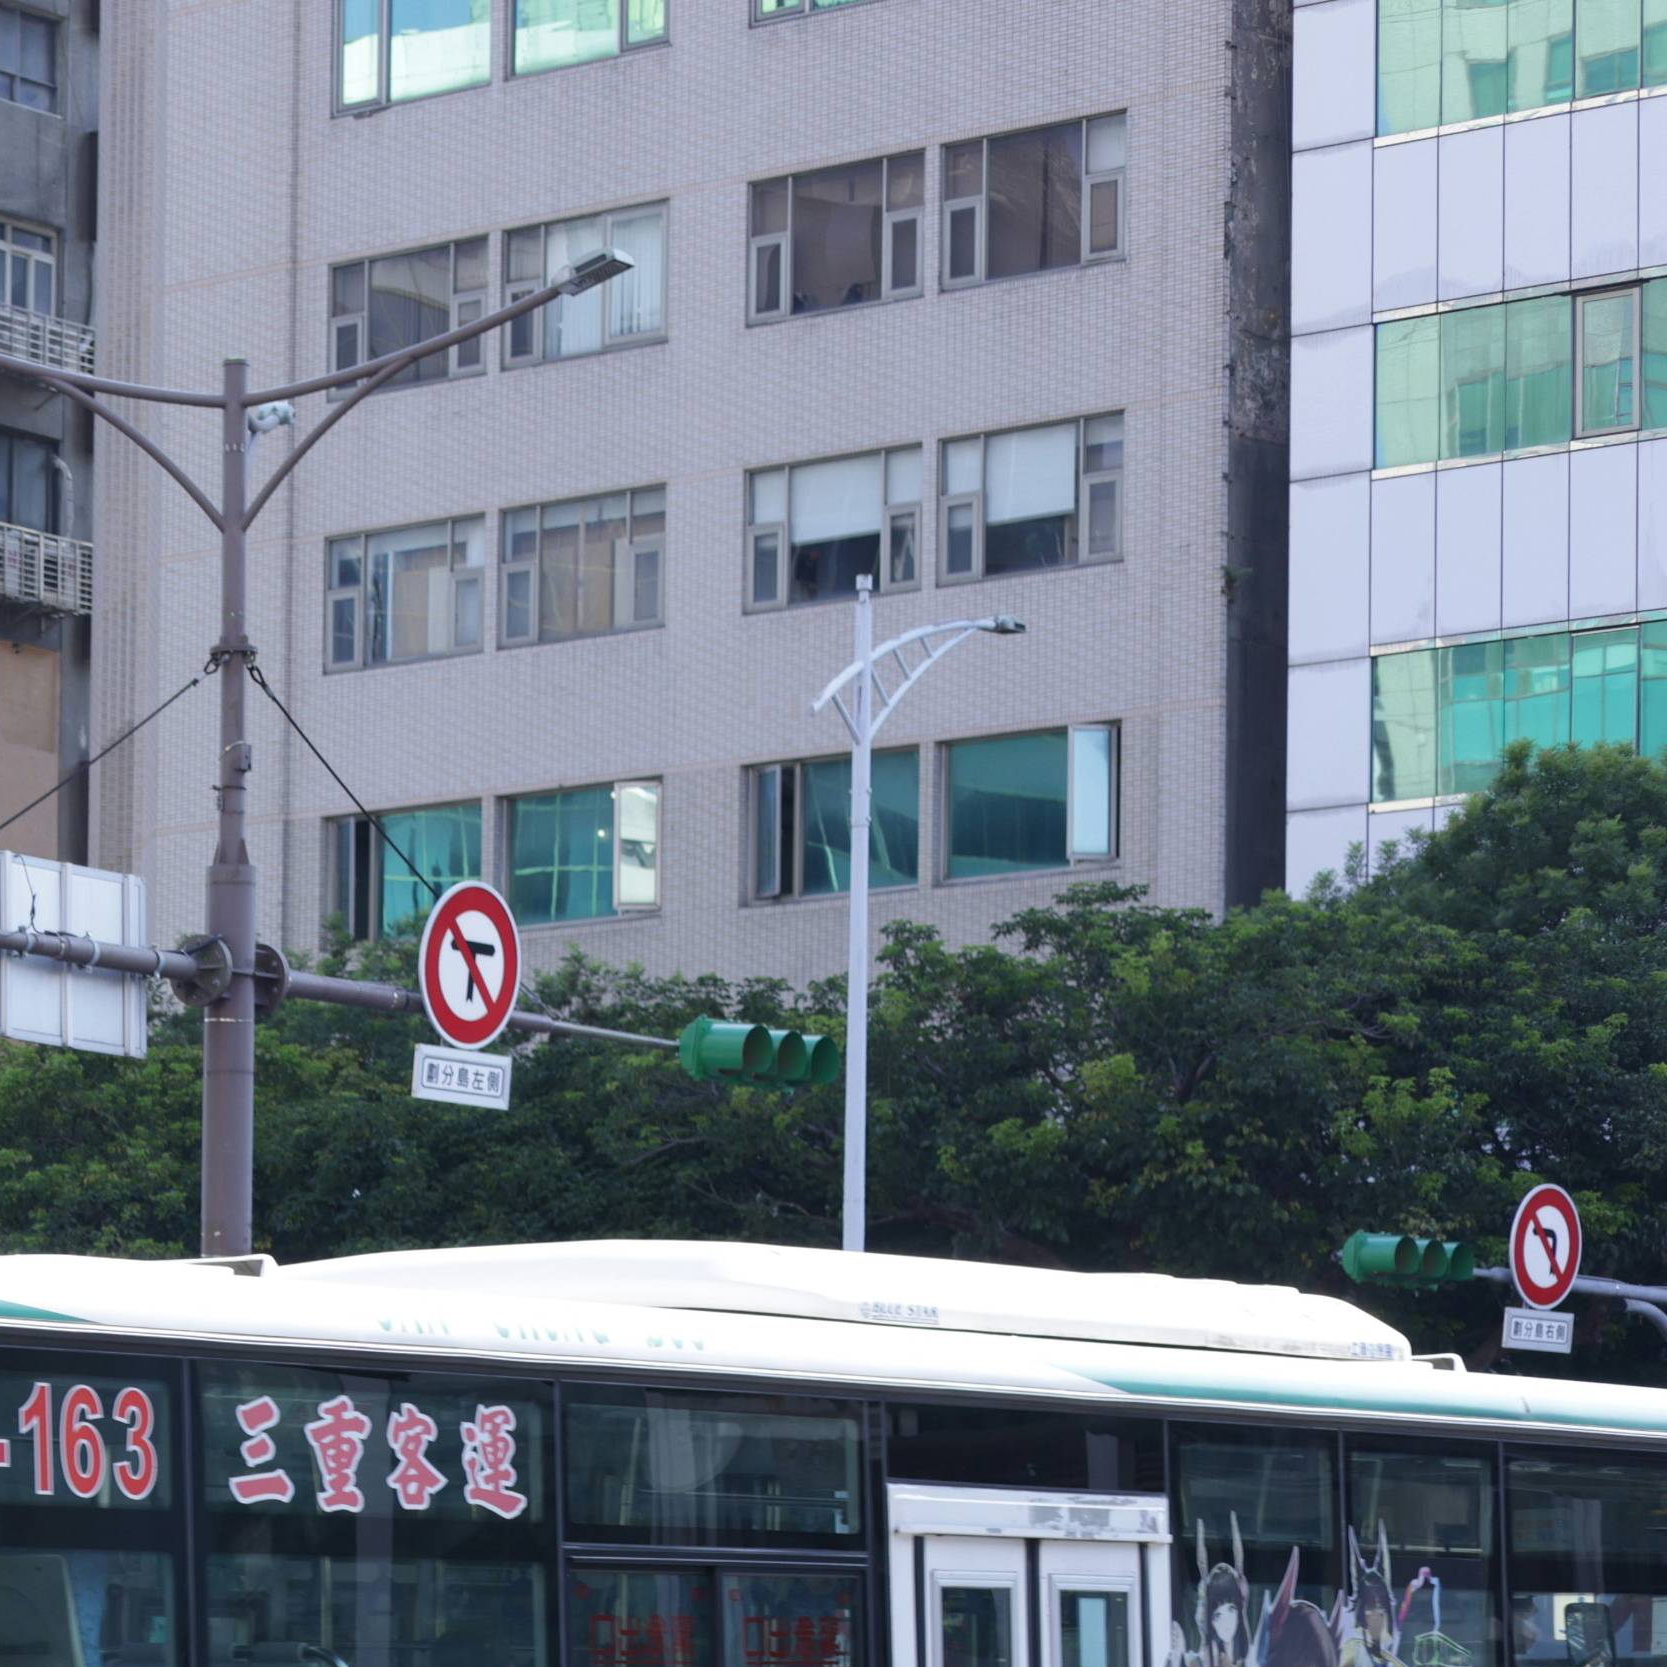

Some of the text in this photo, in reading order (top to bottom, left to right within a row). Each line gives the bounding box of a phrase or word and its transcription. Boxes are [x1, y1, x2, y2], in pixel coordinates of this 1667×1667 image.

[426, 1062, 501, 1093] 劃分島左側
[229, 1394, 528, 1519] 三重客運
